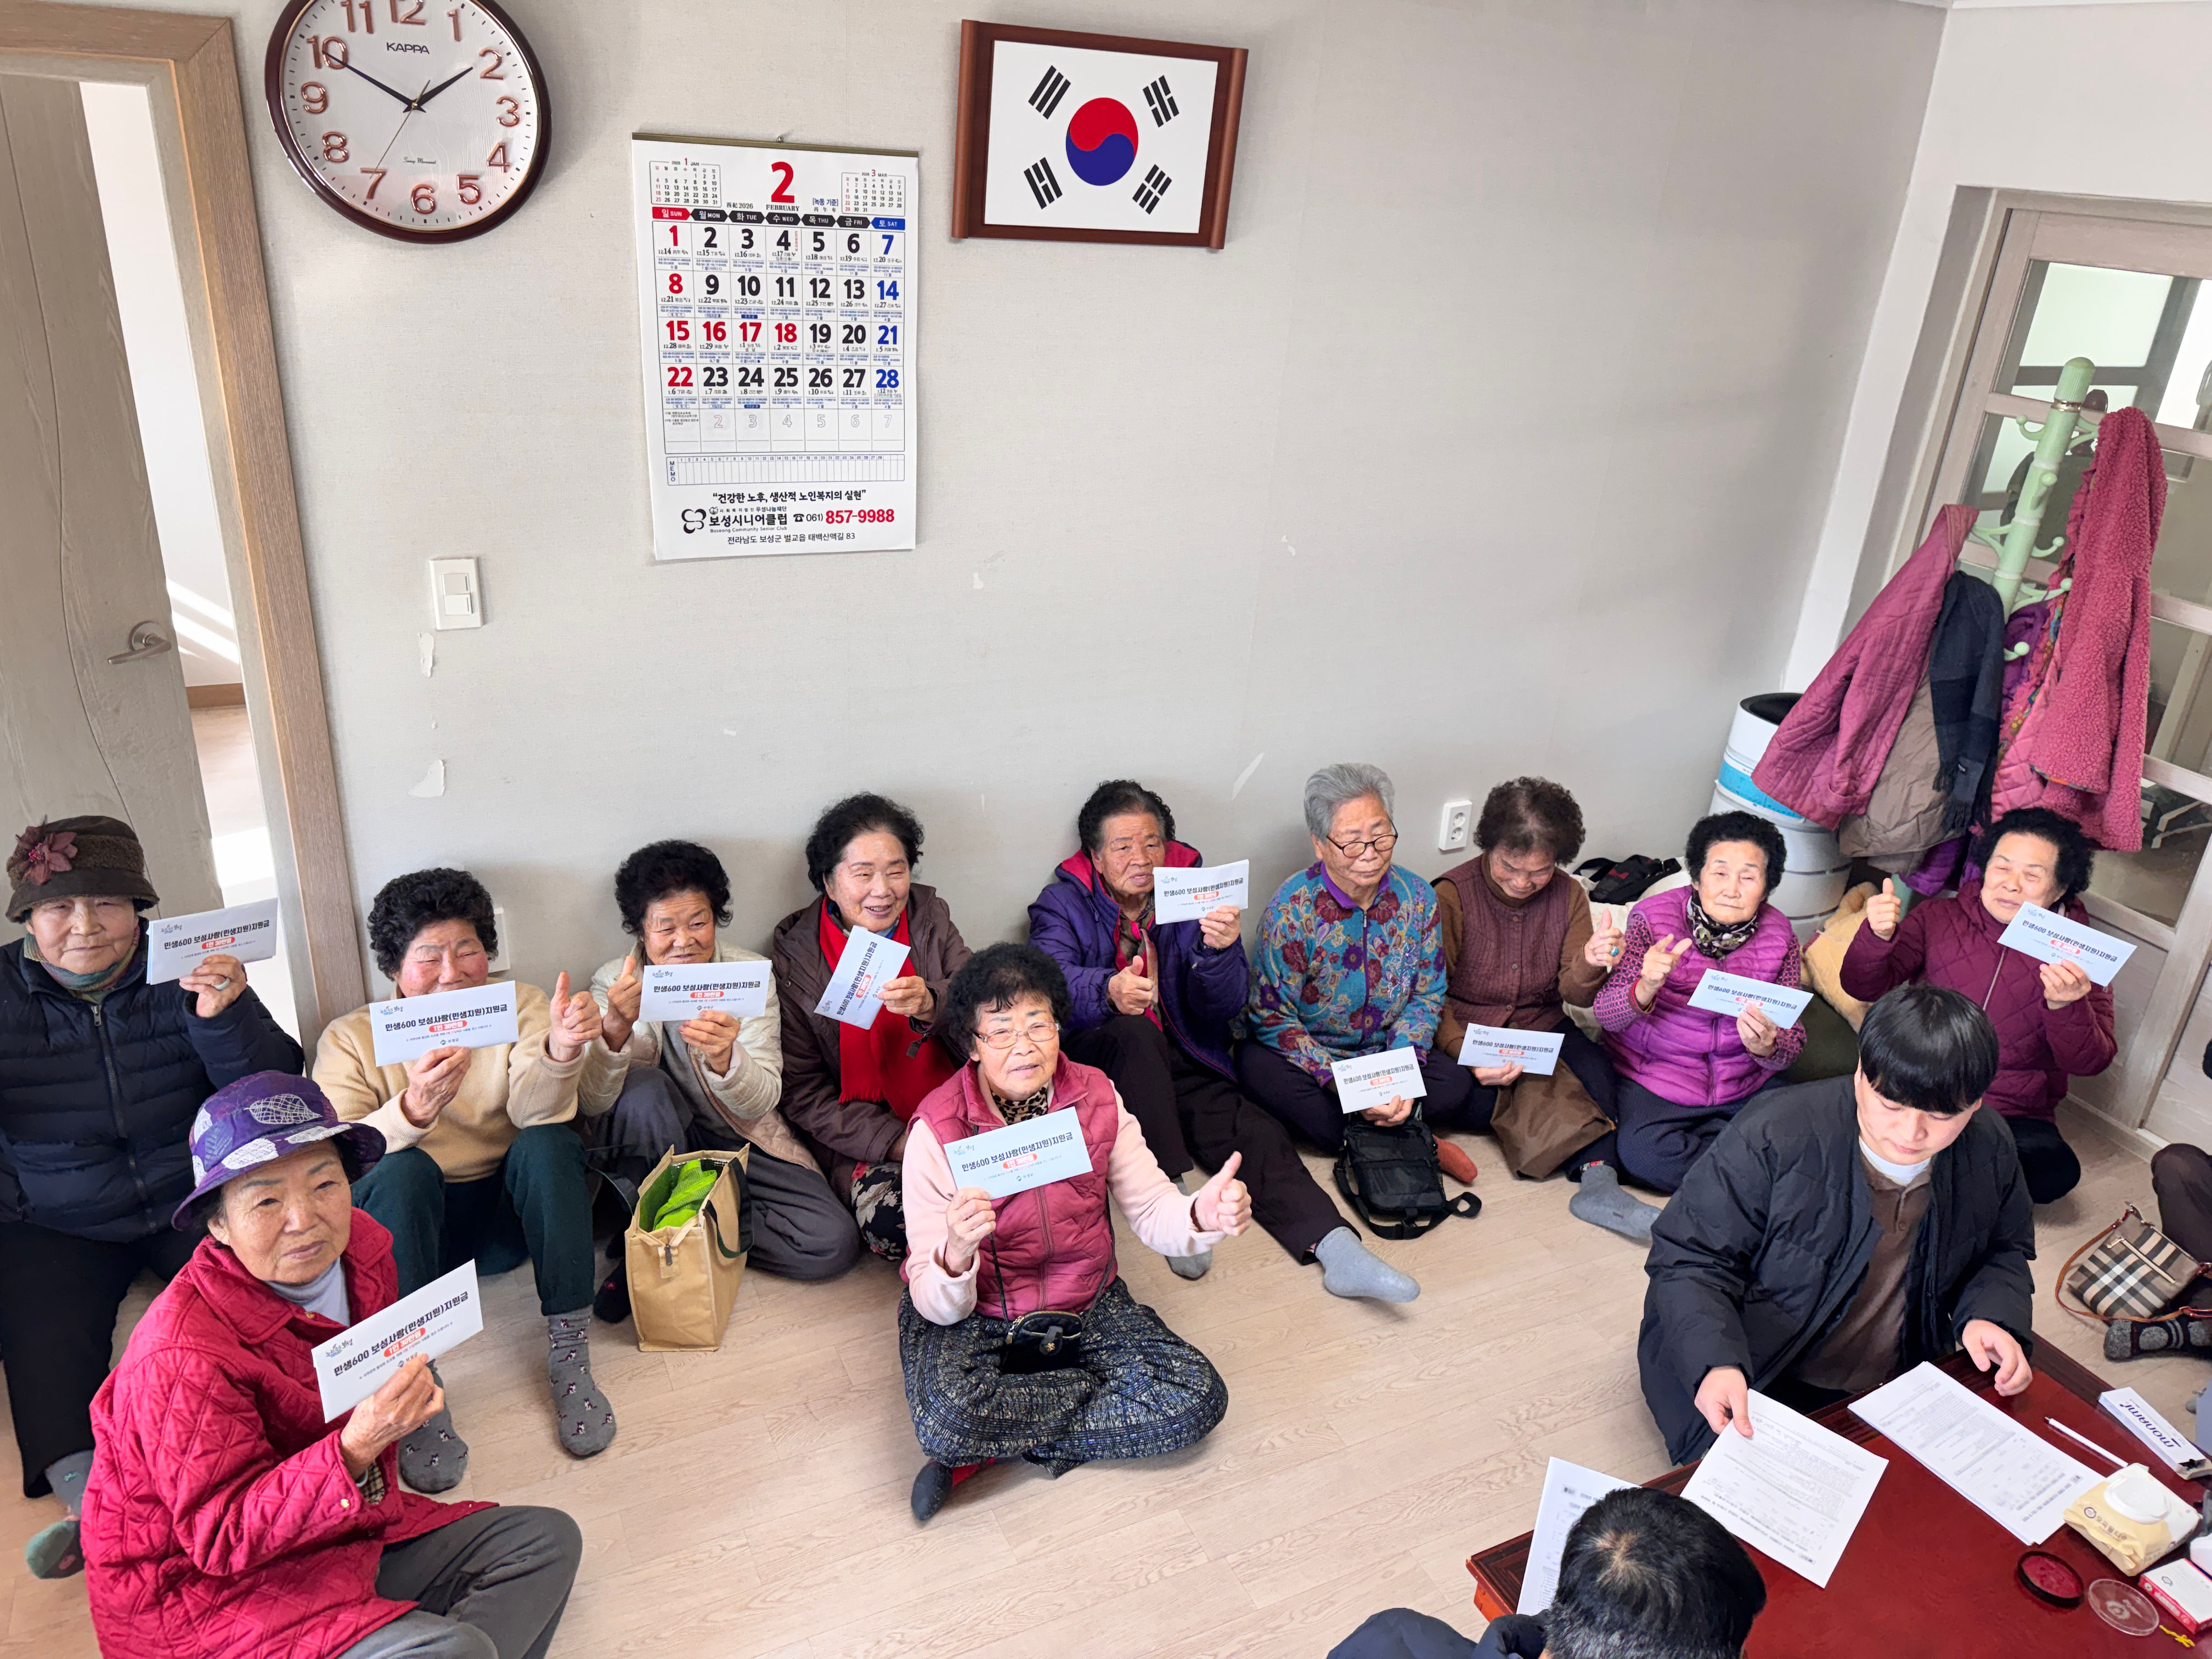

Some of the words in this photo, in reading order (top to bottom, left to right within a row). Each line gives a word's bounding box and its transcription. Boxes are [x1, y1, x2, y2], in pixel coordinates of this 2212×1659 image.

[341, 0, 374, 34] 11
[390, 0, 425, 25] 12
[447, 9, 461, 41] 1
[307, 35, 348, 70] 10
[386, 42, 430, 54] KAPPA
[479, 48, 504, 80] 2
[301, 82, 328, 114] 9
[496, 97, 520, 127] 3
[321, 131, 348, 162] 8
[487, 142, 510, 173] 4
[360, 167, 386, 199] 7
[456, 174, 481, 205] 5
[771, 162, 795, 203] 2
[410, 184, 436, 215] 6
[662, 209, 669, 217] 일
[699, 211, 706, 219] 월
[772, 215, 781, 223] 수
[809, 216, 816, 224] 목
[669, 225, 678, 246] 1
[704, 227, 718, 247] 2
[741, 228, 754, 249] 3
[776, 230, 791, 251] 4
[813, 232, 825, 252] 5
[848, 233, 860, 253] 6
[882, 234, 894, 255] 7
[669, 273, 683, 294] 8
[706, 274, 719, 295] 9
[737, 275, 760, 296] 10
[776, 277, 794, 297] 11
[809, 278, 831, 298] 12
[844, 279, 865, 299] 13
[877, 280, 899, 300] 14
[666, 320, 690, 341] 15
[702, 321, 726, 341] 16
[739, 322, 761, 342] 17
[775, 323, 797, 342] 18
[809, 324, 831, 343] 19
[842, 324, 866, 344] 20
[878, 325, 897, 345] 21
[667, 367, 693, 387] 22
[703, 367, 729, 387] 23
[738, 367, 764, 387] 24
[774, 368, 798, 387] 25
[809, 368, 832, 387] 26
[843, 369, 866, 388] 27
[876, 369, 899, 388] 28
[714, 415, 723, 428] 2
[749, 415, 757, 427] 3
[783, 415, 792, 427] 4
[817, 414, 826, 427] 5
[851, 415, 860, 427] 6
[884, 415, 892, 427] 7
[747, 493, 768, 503] 노후,
[770, 492, 796, 502] 생산적
[799, 490, 842, 501] 노인복지의
[709, 514, 787, 527] 보성시니어클럽
[806, 514, 823, 522] 061)
[826, 509, 894, 524] 857-9988
[727, 535, 757, 544] 전라남도
[784, 534, 805, 542] 벌교읍
[809, 533, 844, 541] 태백산맥길
[164, 938, 192, 949] 민생600
[194, 919, 270, 943] 보성사랑(민생지원)지원금
[385, 1020, 416, 1031] 민생600
[419, 1004, 507, 1026] 보성사랑(민생지원)지원금
[961, 1158, 990, 1172] 민생600
[991, 1132, 1073, 1164] 보성사랑(민생지원)지원금
[334, 1349, 369, 1376] 민생600
[371, 1291, 469, 1355] 보성사랑(민생지원)지원금
[2119, 1403, 2174, 1447] monami
